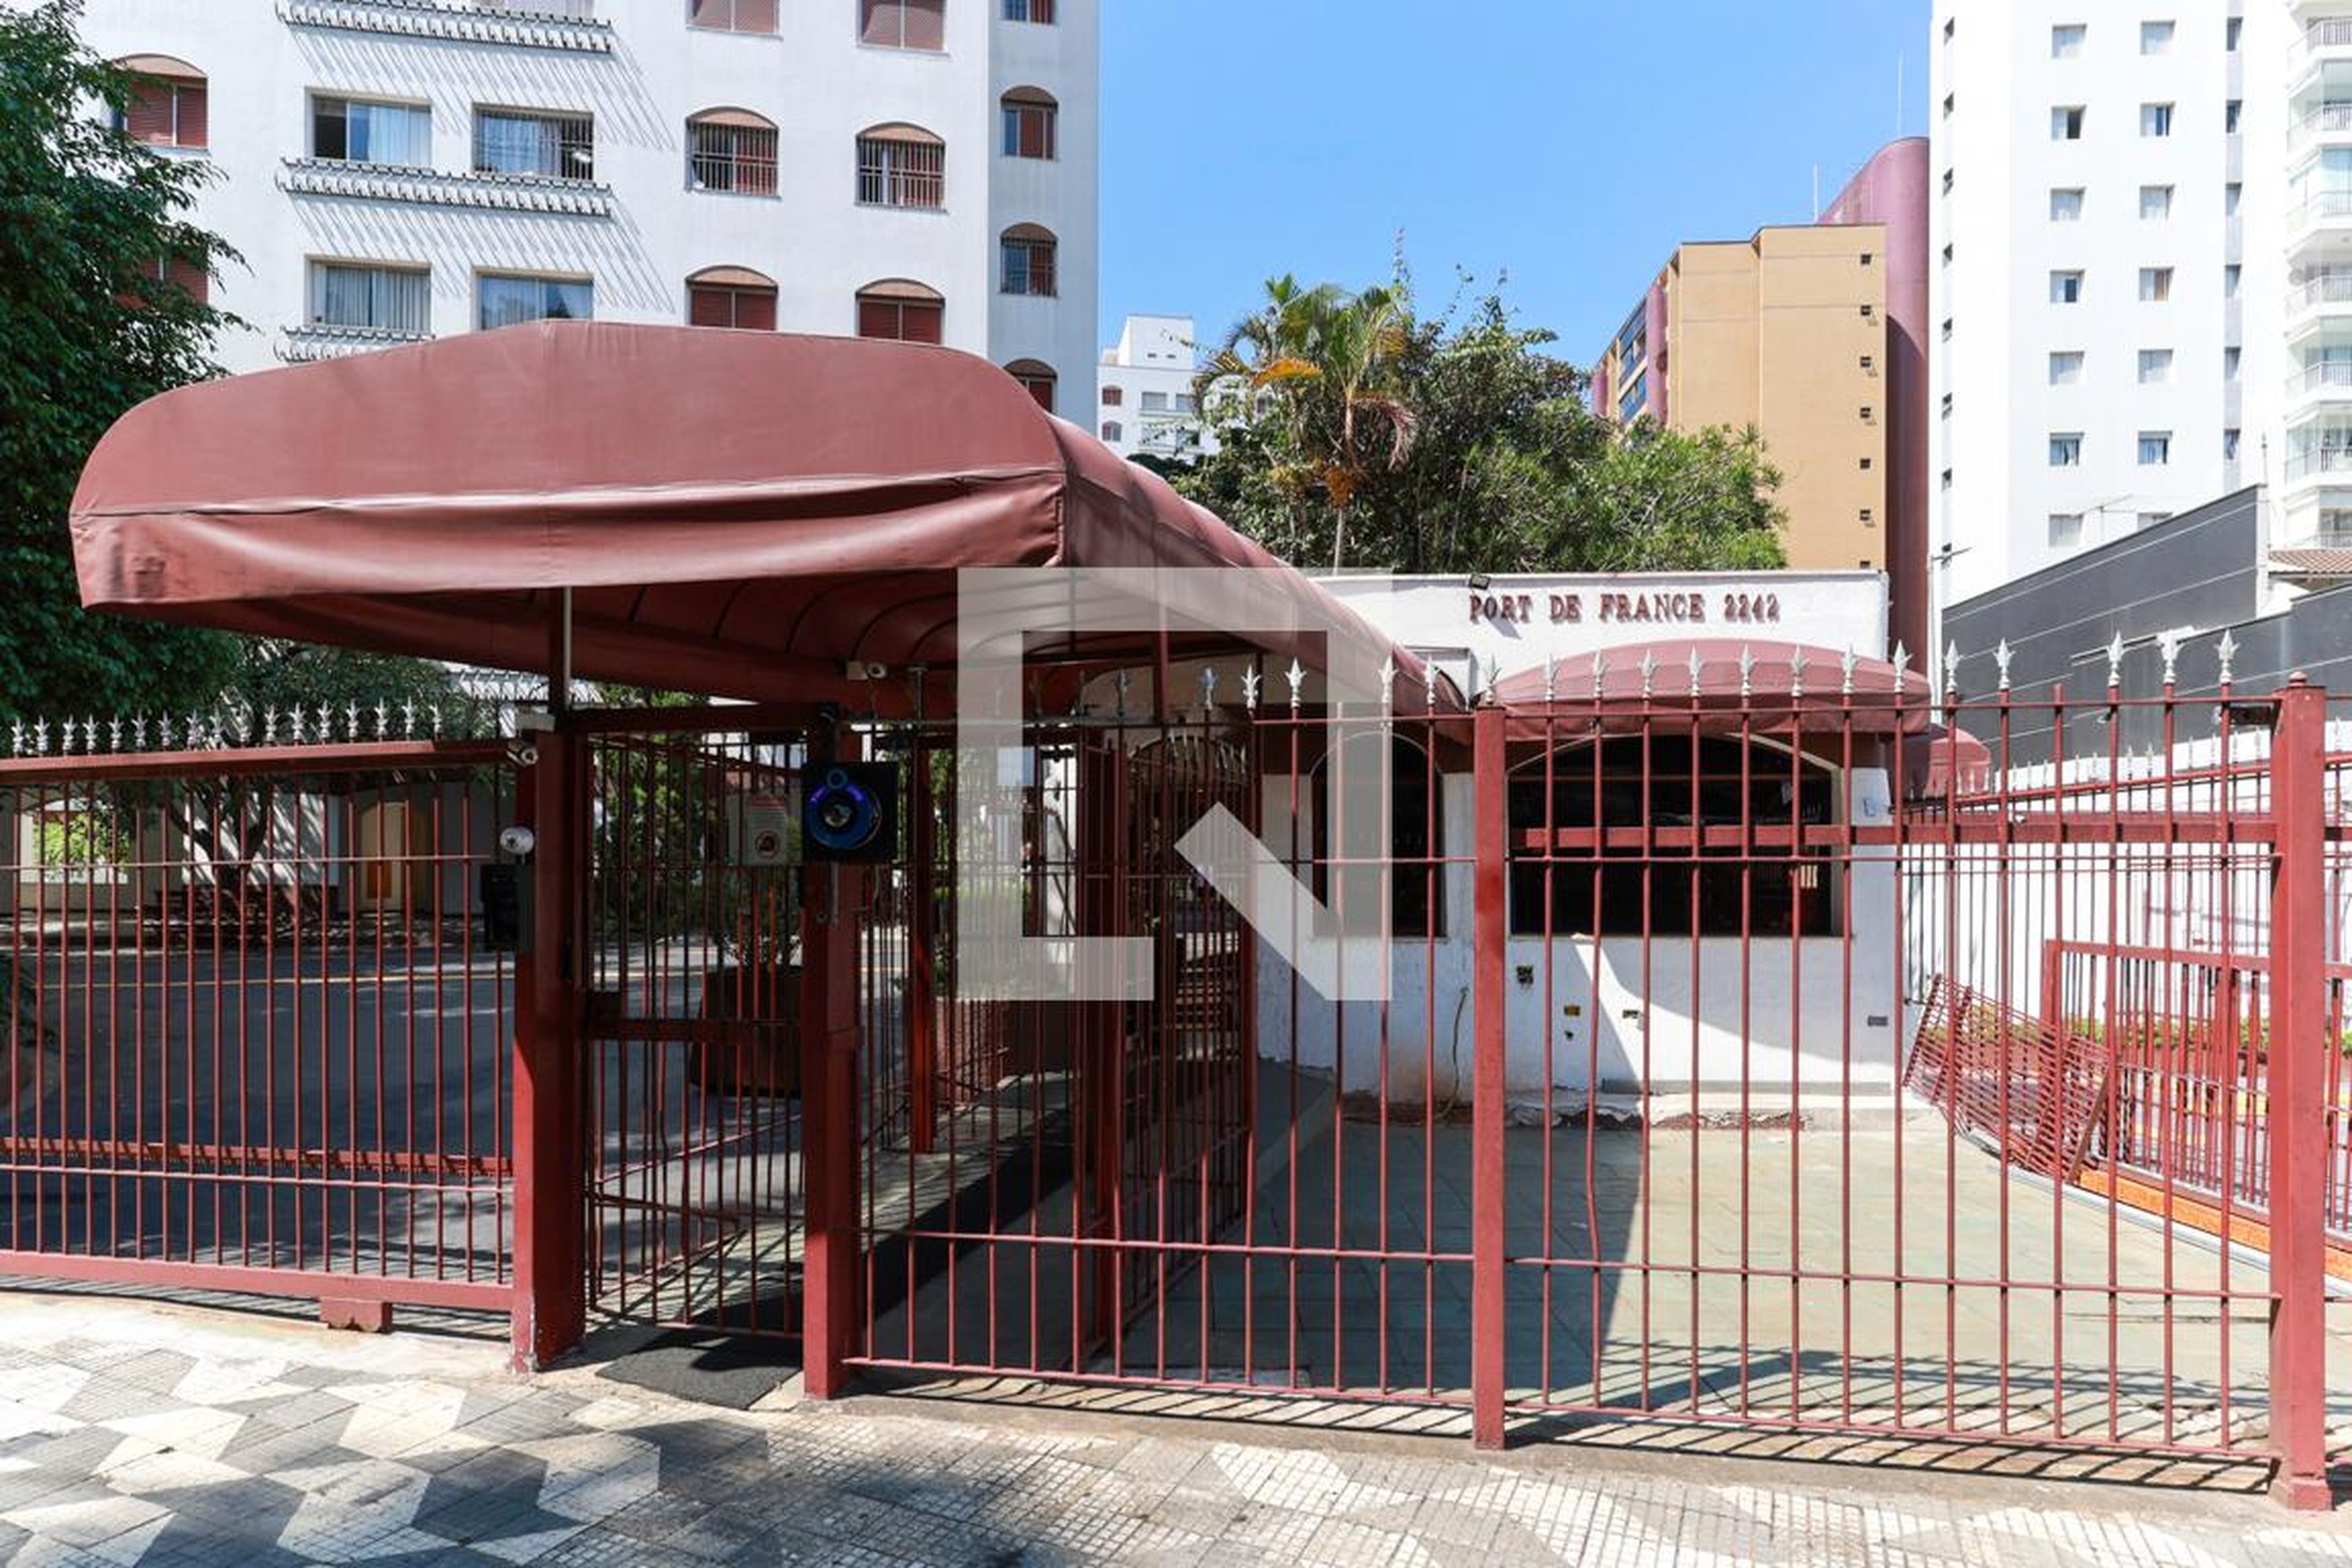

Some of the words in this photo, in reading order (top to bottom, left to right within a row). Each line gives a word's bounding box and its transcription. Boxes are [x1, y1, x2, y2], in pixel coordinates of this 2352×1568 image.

[1470, 595, 1531, 623] PORT
[1549, 594, 1582, 622] DE
[1599, 593, 1706, 623] FRANCE
[1724, 594, 1780, 623] 2242
